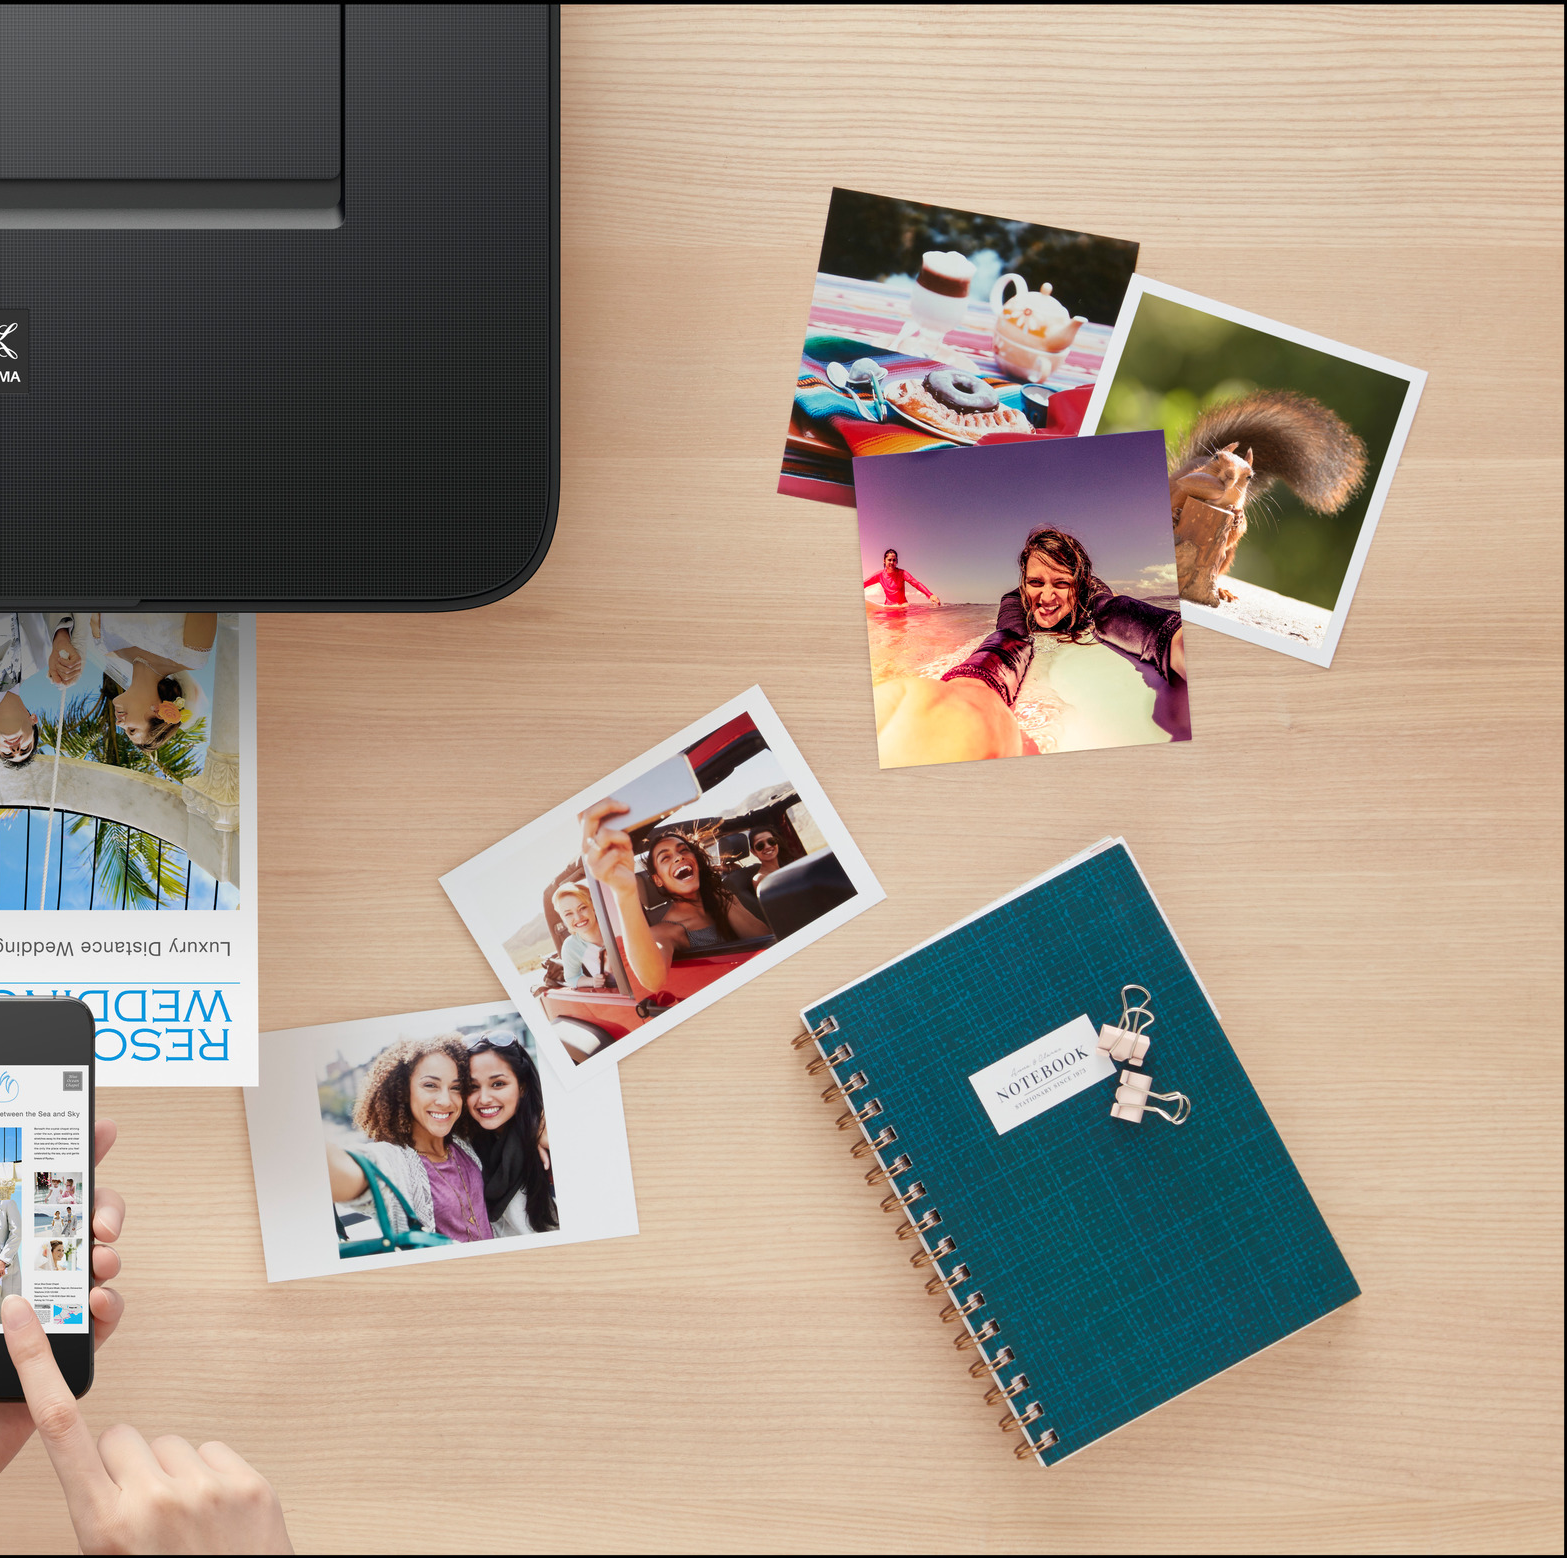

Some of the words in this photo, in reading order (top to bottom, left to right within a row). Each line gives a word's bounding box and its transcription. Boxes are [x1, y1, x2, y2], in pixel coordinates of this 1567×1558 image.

[80, 941, 161, 957] Distance
[168, 937, 231, 957] Luxury
[94, 1028, 229, 1062] RESO
[996, 1045, 1088, 1103] NOTEBOOK
[1015, 1085, 1052, 1109] STATIONARY
[1054, 1077, 1072, 1088] SINCE
[37, 1110, 51, 1118] Sea
[52, 1110, 66, 1118] and
[67, 1110, 81, 1119] Sky
